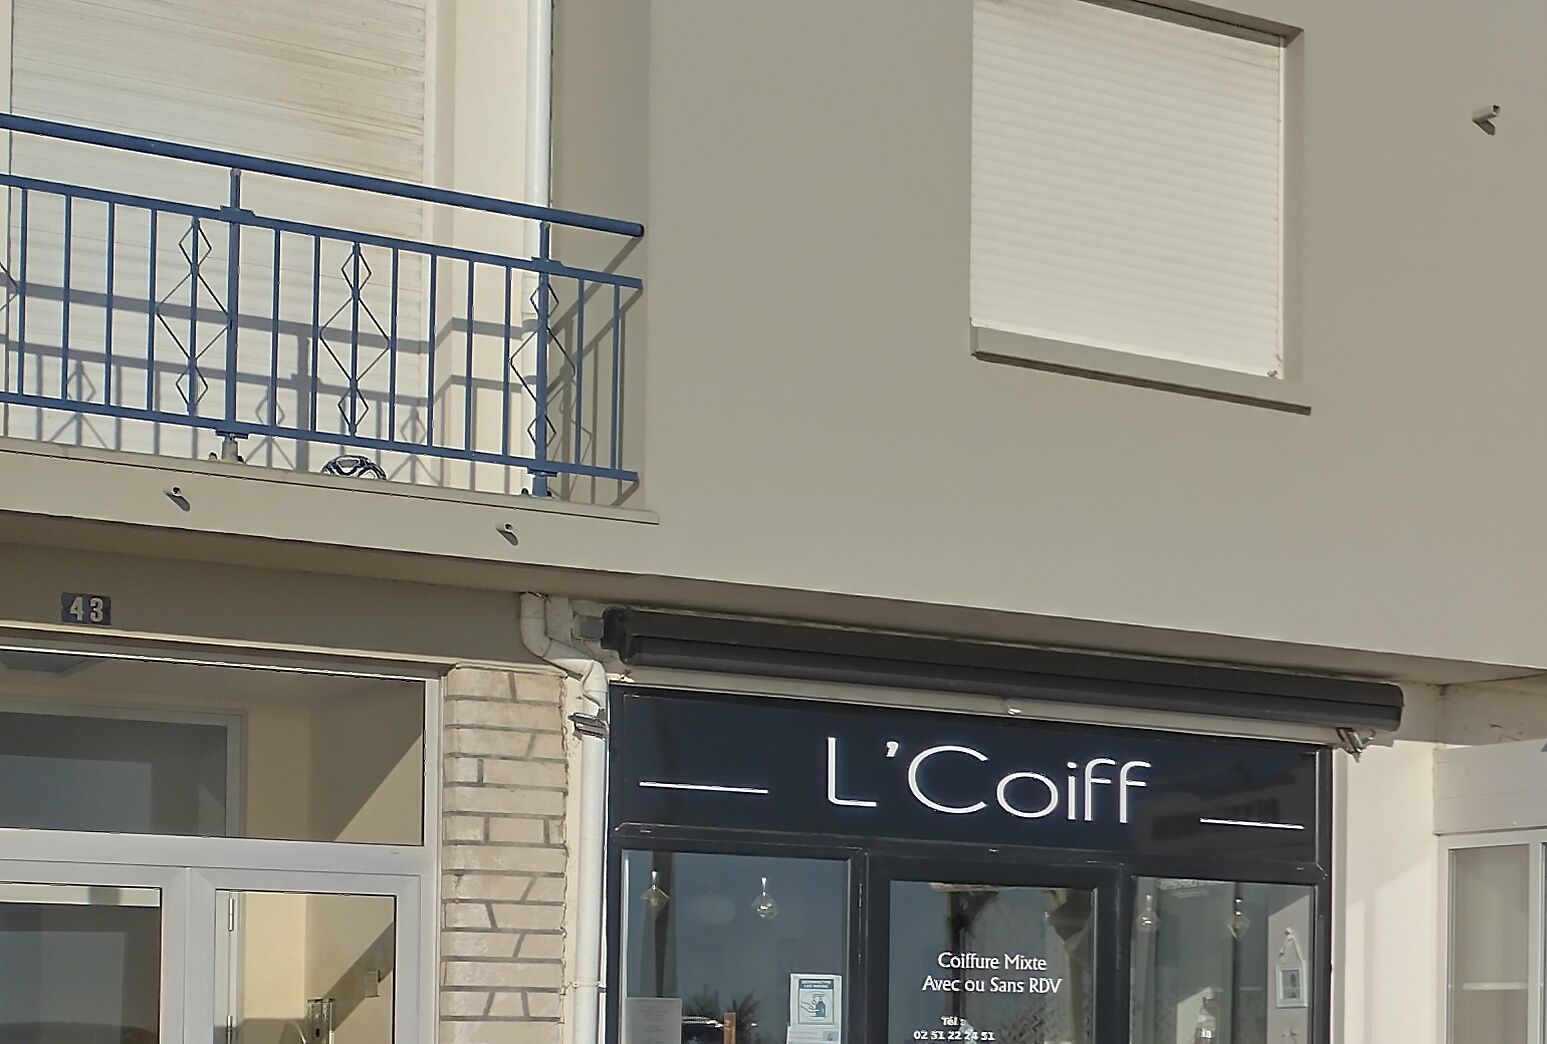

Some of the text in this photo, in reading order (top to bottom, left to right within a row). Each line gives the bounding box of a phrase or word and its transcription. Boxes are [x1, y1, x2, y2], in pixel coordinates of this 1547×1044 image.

[70, 596, 103, 622] 43
[827, 736, 1152, 824] L'Coiff
[938, 951, 1047, 970] Coiffure Mixte
[921, 975, 1062, 993] Avec ou Sans RDV
[913, 1030, 928, 1040] 02
